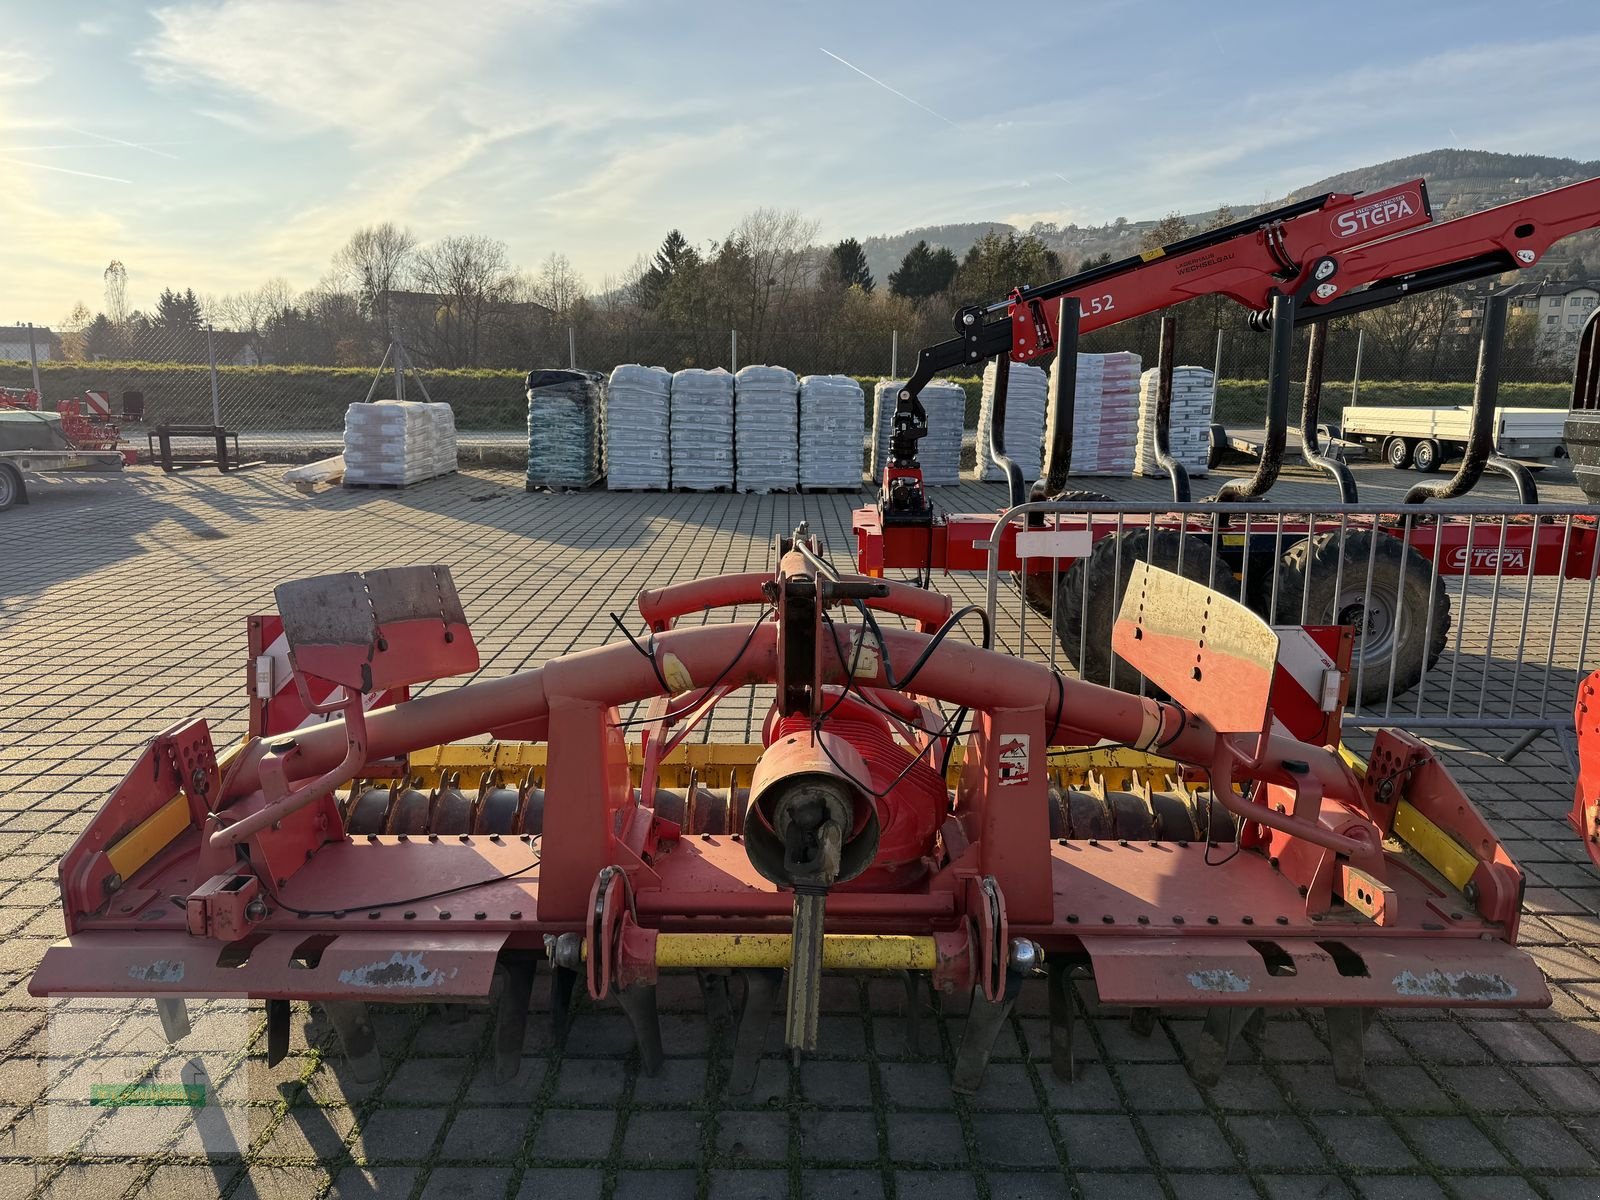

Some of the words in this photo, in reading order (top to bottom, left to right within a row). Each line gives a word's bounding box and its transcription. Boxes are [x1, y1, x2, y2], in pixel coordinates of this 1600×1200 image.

[1337, 200, 1413, 236] STEPA
[1176, 253, 1235, 276] WECHSELGAU
[1453, 548, 1524, 567] STEPA
